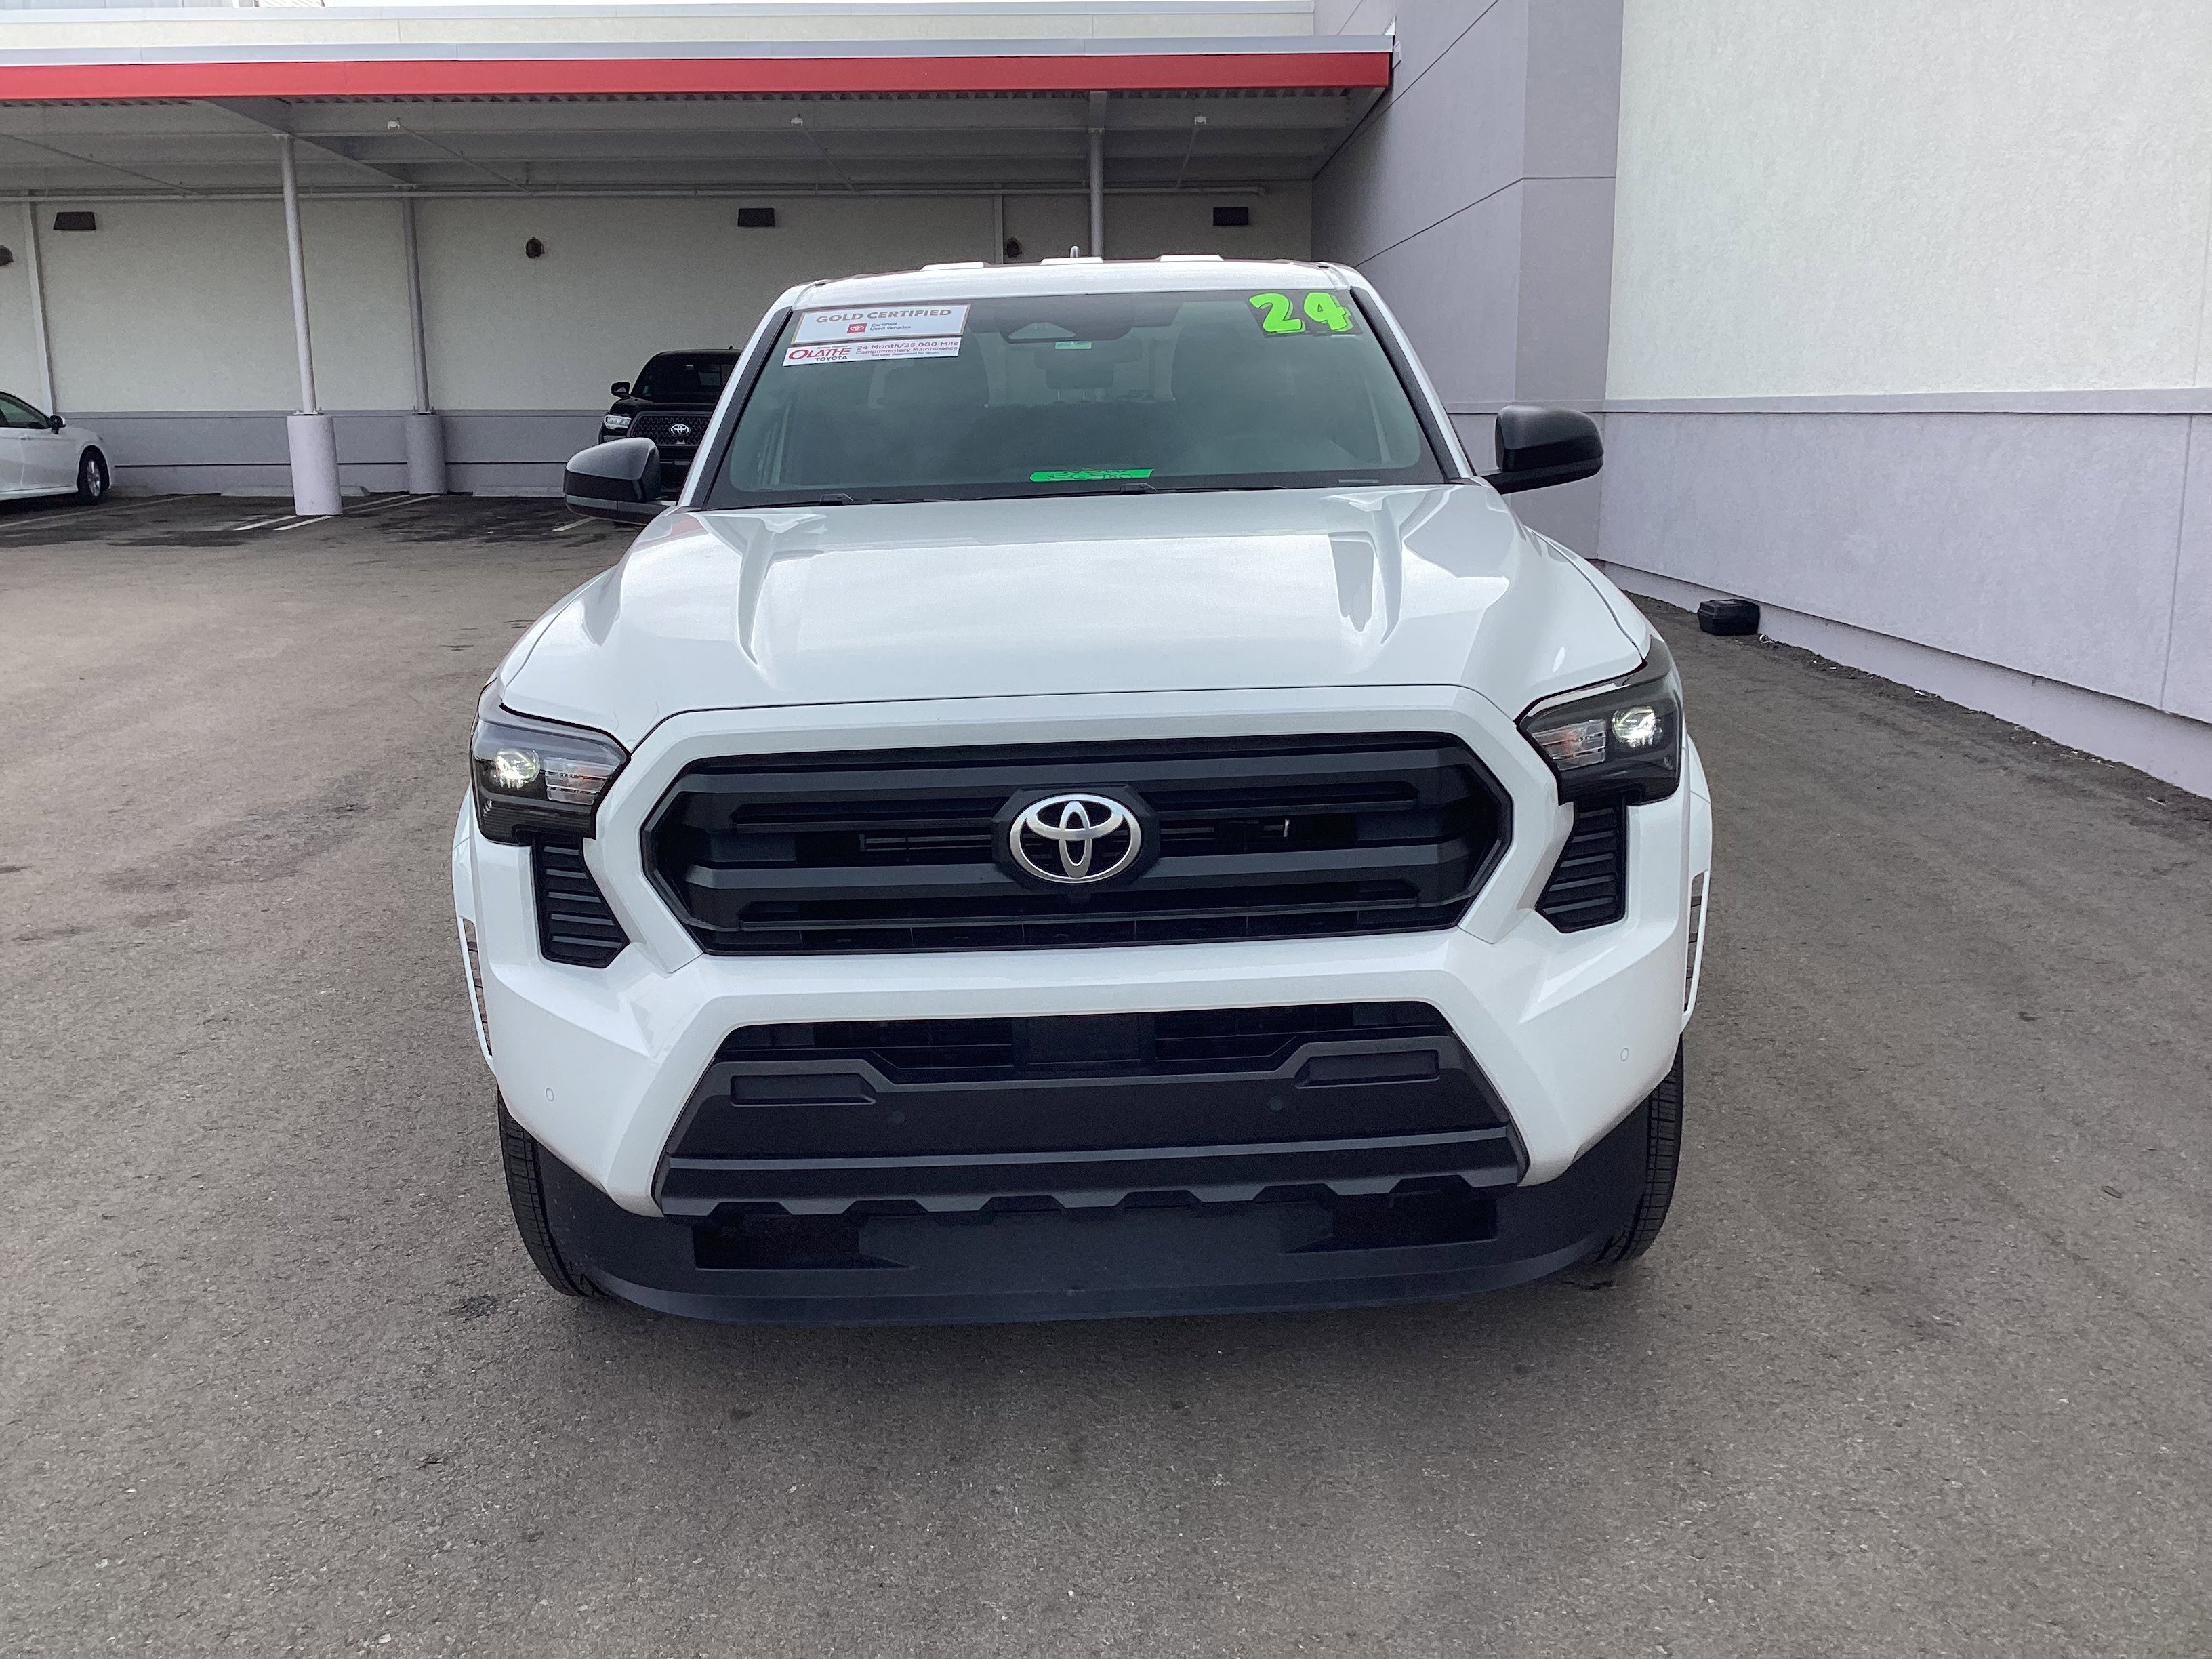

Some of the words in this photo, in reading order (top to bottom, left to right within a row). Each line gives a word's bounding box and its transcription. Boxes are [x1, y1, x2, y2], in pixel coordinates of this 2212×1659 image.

[815, 313, 863, 323] GOLD
[867, 309, 952, 319] CERTIFIED
[1248, 292, 1353, 333] 24
[788, 347, 852, 360] OLATHE
